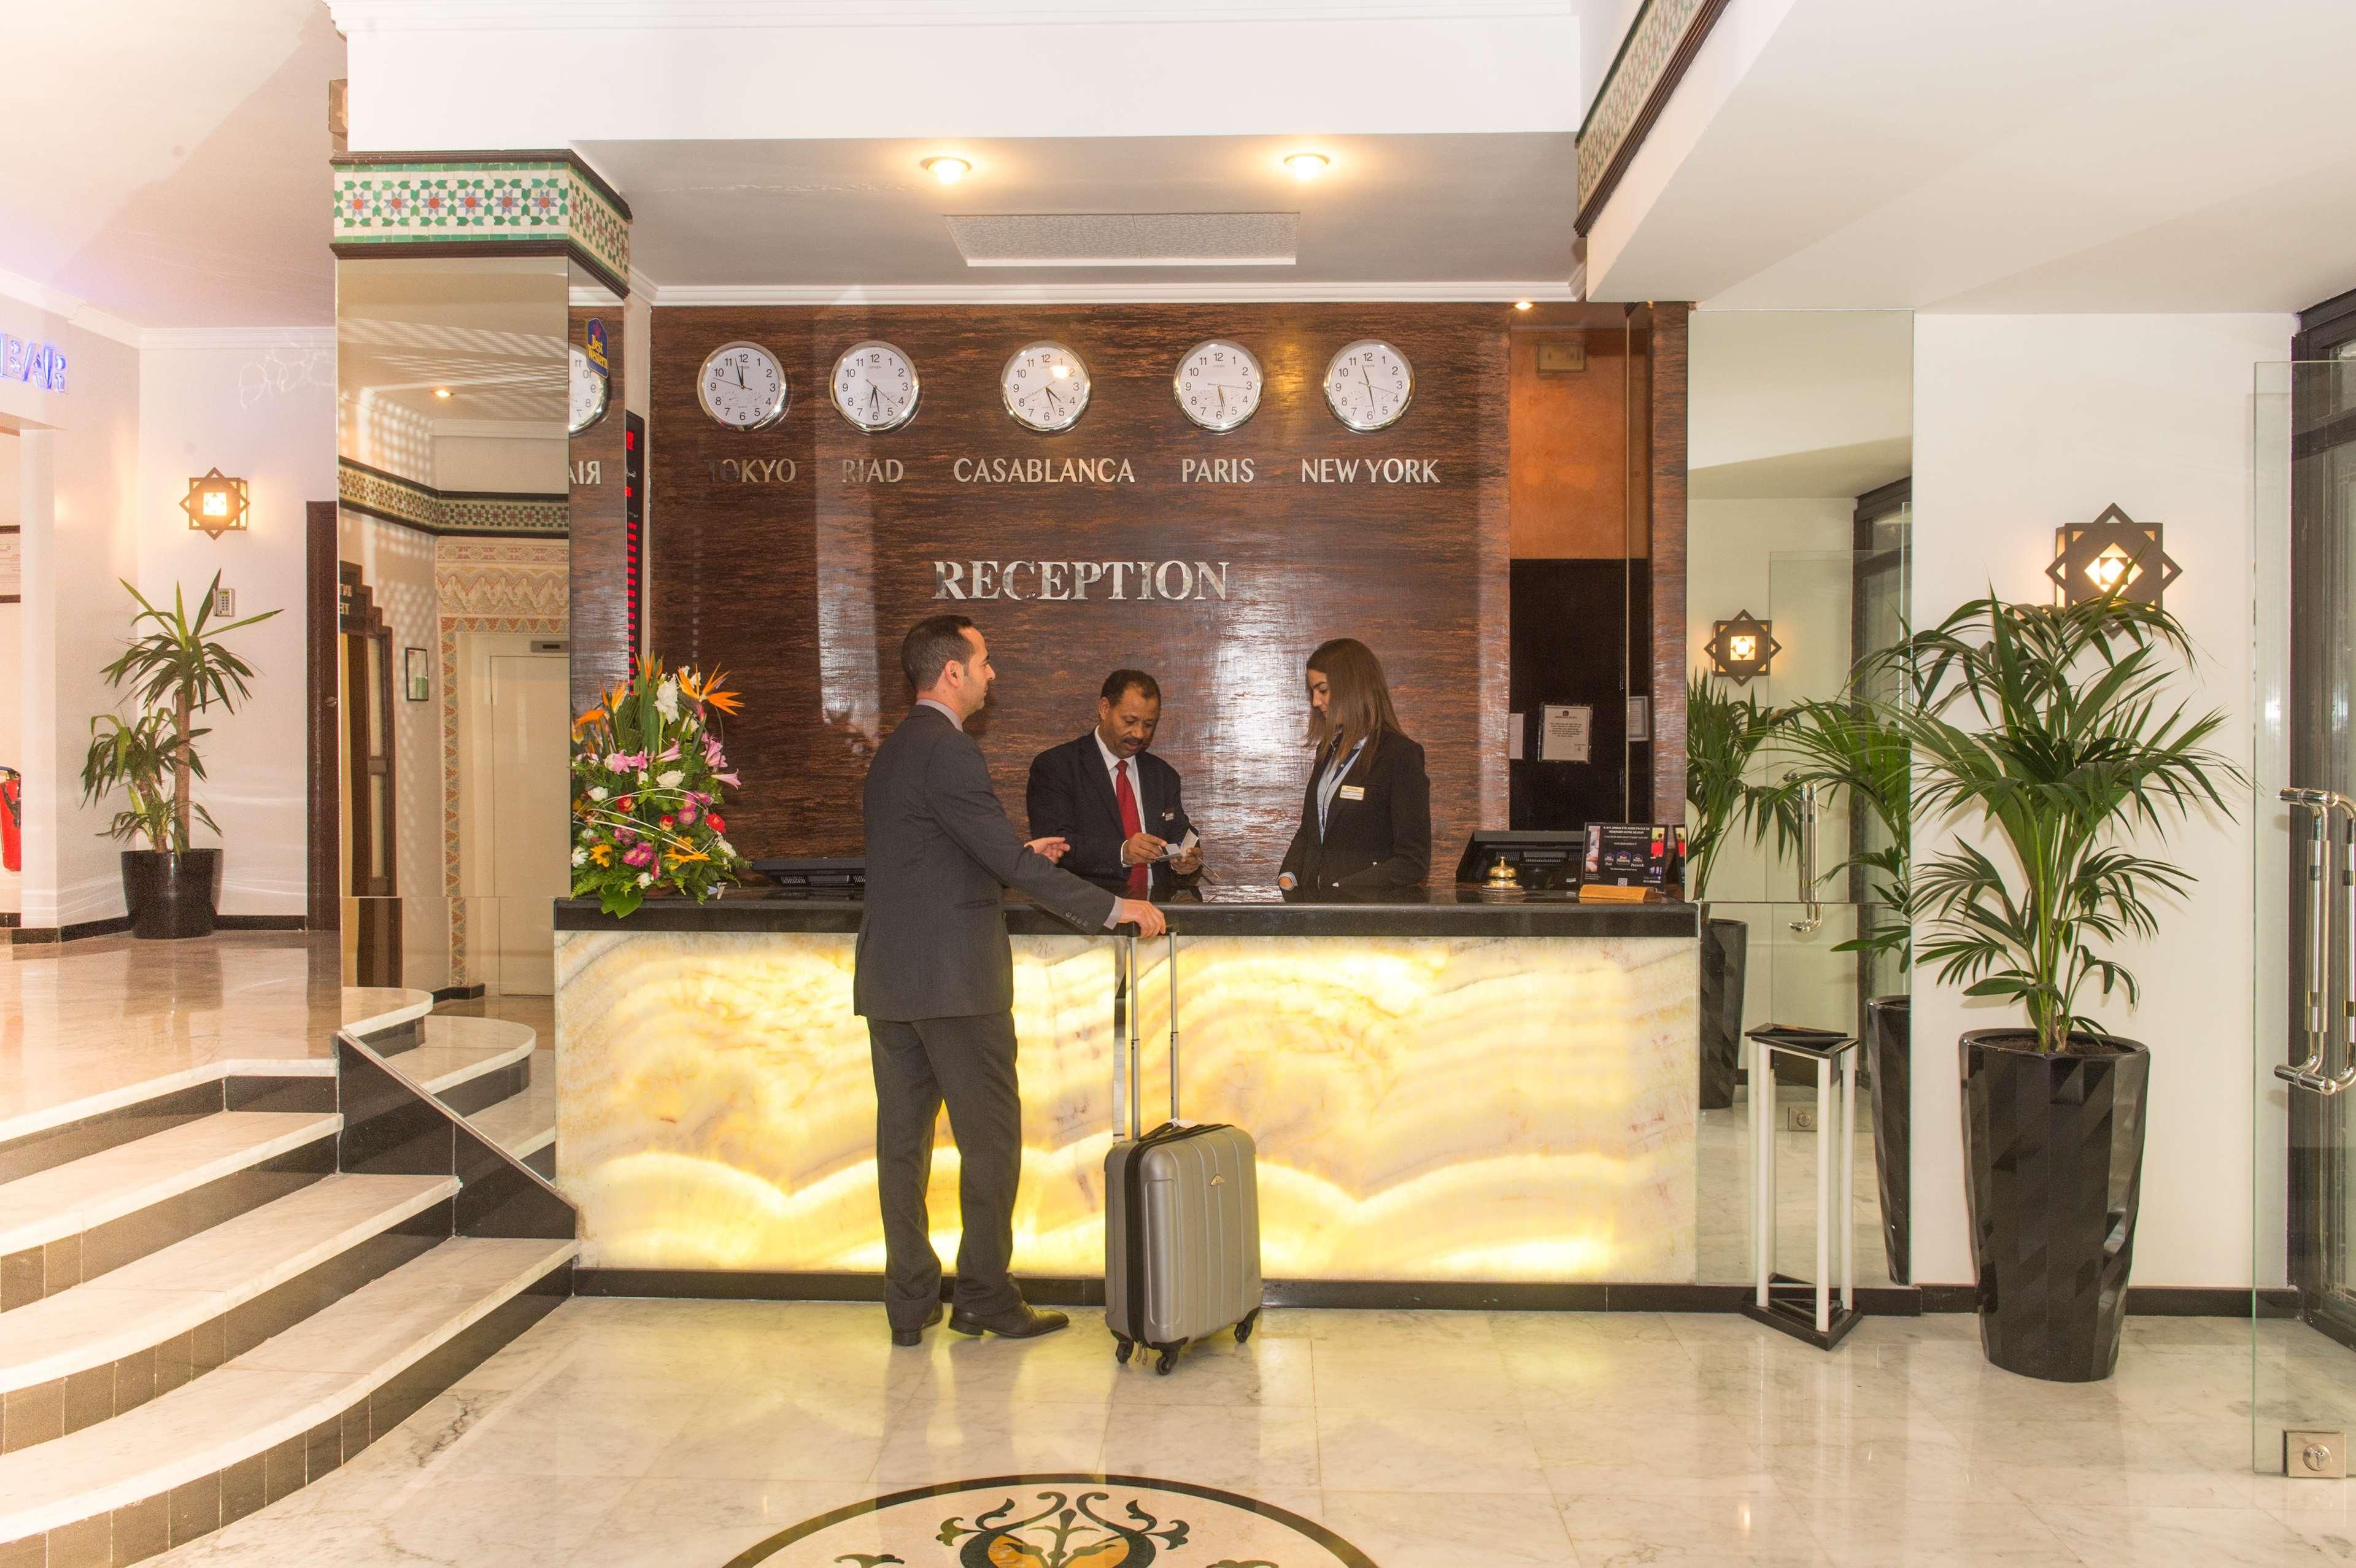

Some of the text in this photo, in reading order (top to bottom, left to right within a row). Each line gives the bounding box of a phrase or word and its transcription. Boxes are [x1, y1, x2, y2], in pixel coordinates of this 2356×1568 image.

[591, 334, 603, 355] Best
[587, 344, 609, 370] Western
[739, 354, 748, 363] 12
[870, 354, 879, 363] 12
[1041, 354, 1051, 363] 12
[1214, 352, 1223, 361] 12
[1232, 356, 1236, 365] 1
[1363, 352, 1373, 361] 12
[0, 333, 66, 393] BAR
[725, 358, 732, 366] 11
[889, 357, 892, 366] 1
[1027, 358, 1034, 367] 11
[1349, 357, 1356, 366] 11
[714, 368, 724, 377] 10
[767, 369, 772, 377] 2
[846, 369, 855, 377] 10
[898, 368, 904, 377] 2
[1016, 369, 1026, 378] 10
[1069, 368, 1075, 377] 2
[1189, 368, 1199, 376] 10
[1242, 367, 1248, 376] 2
[1338, 368, 1348, 377] 10
[1392, 366, 1398, 375] 2
[711, 382, 716, 391] 9
[843, 383, 848, 392] 9
[902, 382, 908, 391] 3
[1013, 384, 1019, 393] 9
[1073, 382, 1080, 391] 3
[1186, 382, 1192, 391] 9
[1246, 381, 1253, 390] 3
[1335, 383, 1342, 392] 9
[1396, 380, 1402, 389] 3
[716, 397, 722, 406] 8
[848, 398, 854, 406] 8
[898, 396, 904, 405] 4
[1019, 398, 1025, 407] 8
[1191, 396, 1197, 405] 8
[1342, 397, 1347, 406] 8
[725, 407, 730, 416] 7
[754, 407, 760, 416] 5
[857, 408, 863, 417] 7
[887, 407, 894, 416] 5
[1029, 409, 1034, 417] 7
[1059, 407, 1065, 416] 5
[1200, 407, 1207, 415] 7
[1351, 407, 1357, 416] 7
[1382, 406, 1388, 415] 5
[740, 412, 746, 420] 6
[873, 412, 879, 420] 6
[1044, 412, 1050, 421] 6
[1216, 411, 1222, 420] 6
[1367, 411, 1373, 420] 6
[705, 458, 796, 483] TOKYO
[842, 458, 904, 483] RIAD
[953, 458, 1135, 483] CASABLANCA
[1182, 458, 1255, 483] PARIS
[1302, 458, 1441, 484] NEW YORK
[931, 560, 1230, 600] RECEPTION
